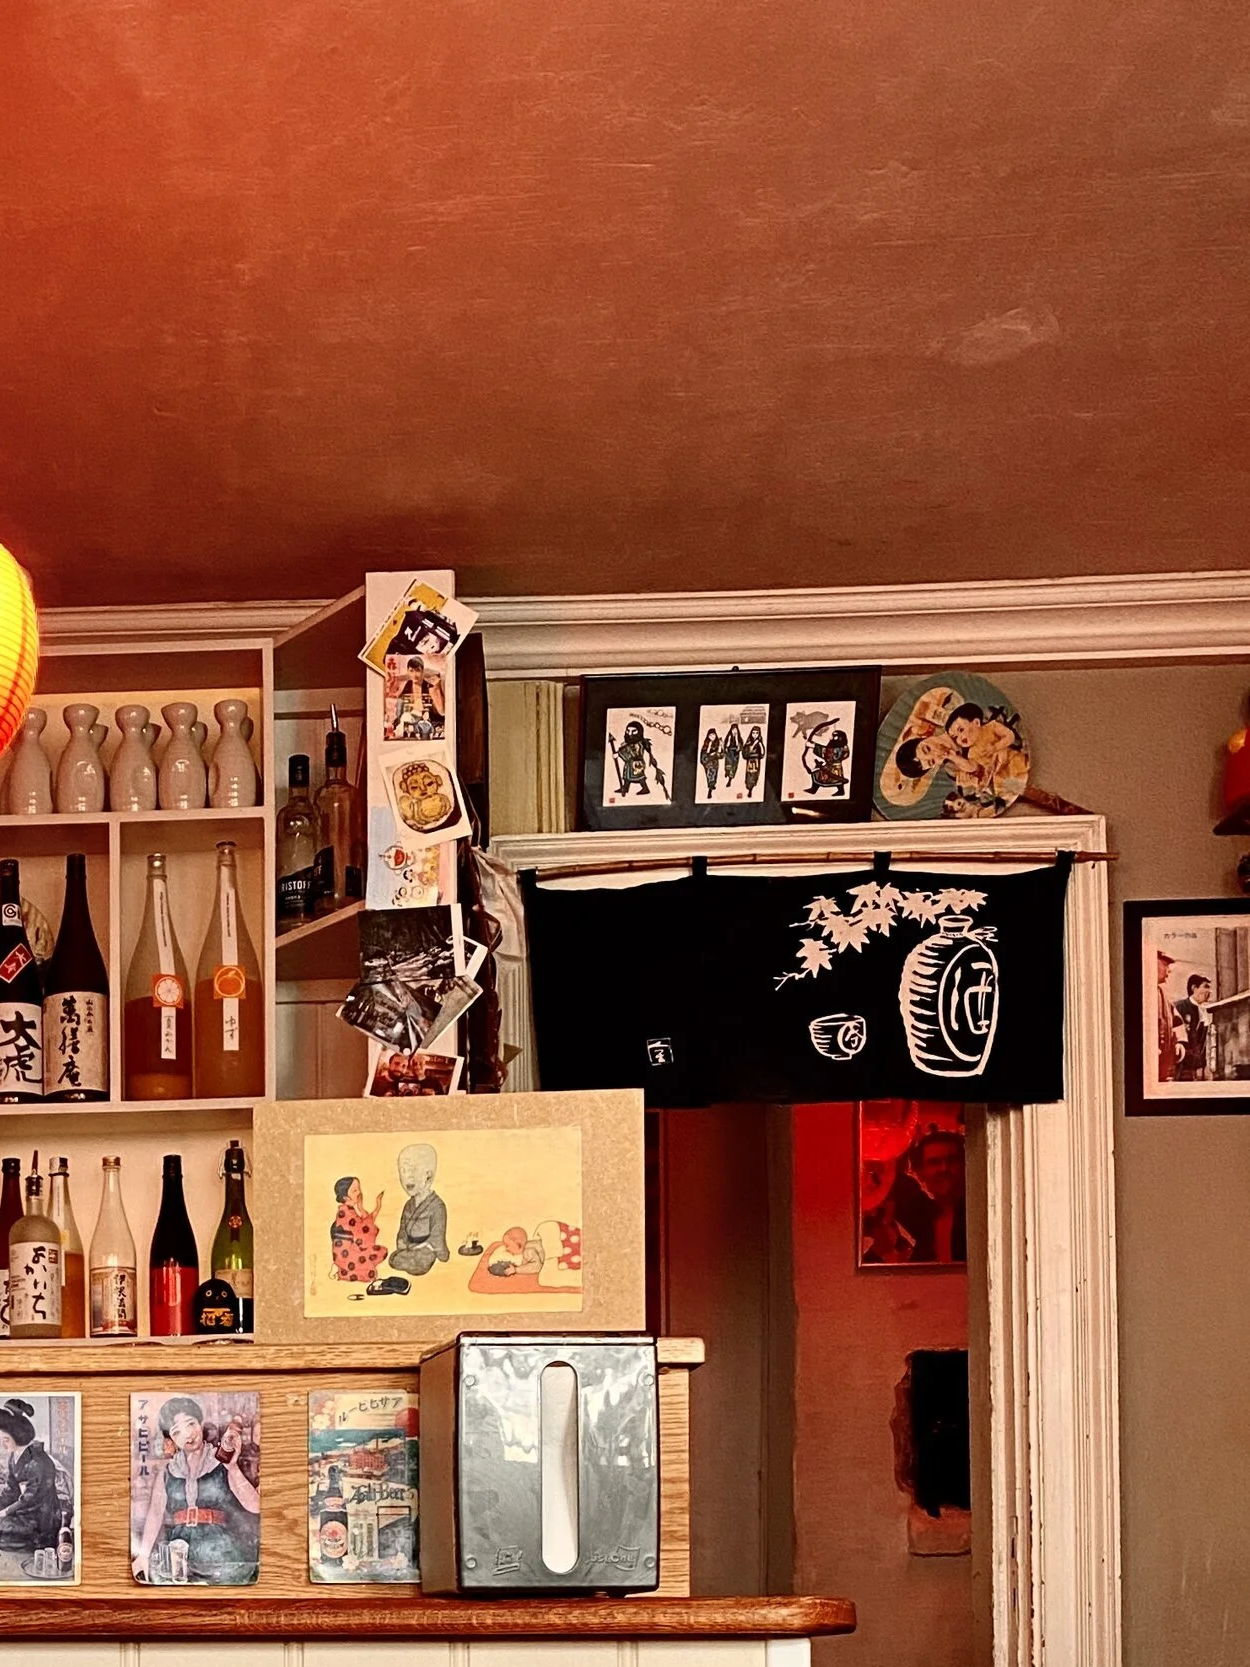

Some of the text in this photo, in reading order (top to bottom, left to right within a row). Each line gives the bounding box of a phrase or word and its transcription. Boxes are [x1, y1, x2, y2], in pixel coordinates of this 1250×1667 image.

[224, 1015, 239, 1040] ゆず
[23, 1245, 47, 1321] よかいち
[137, 1399, 150, 1477] アサヒビール
